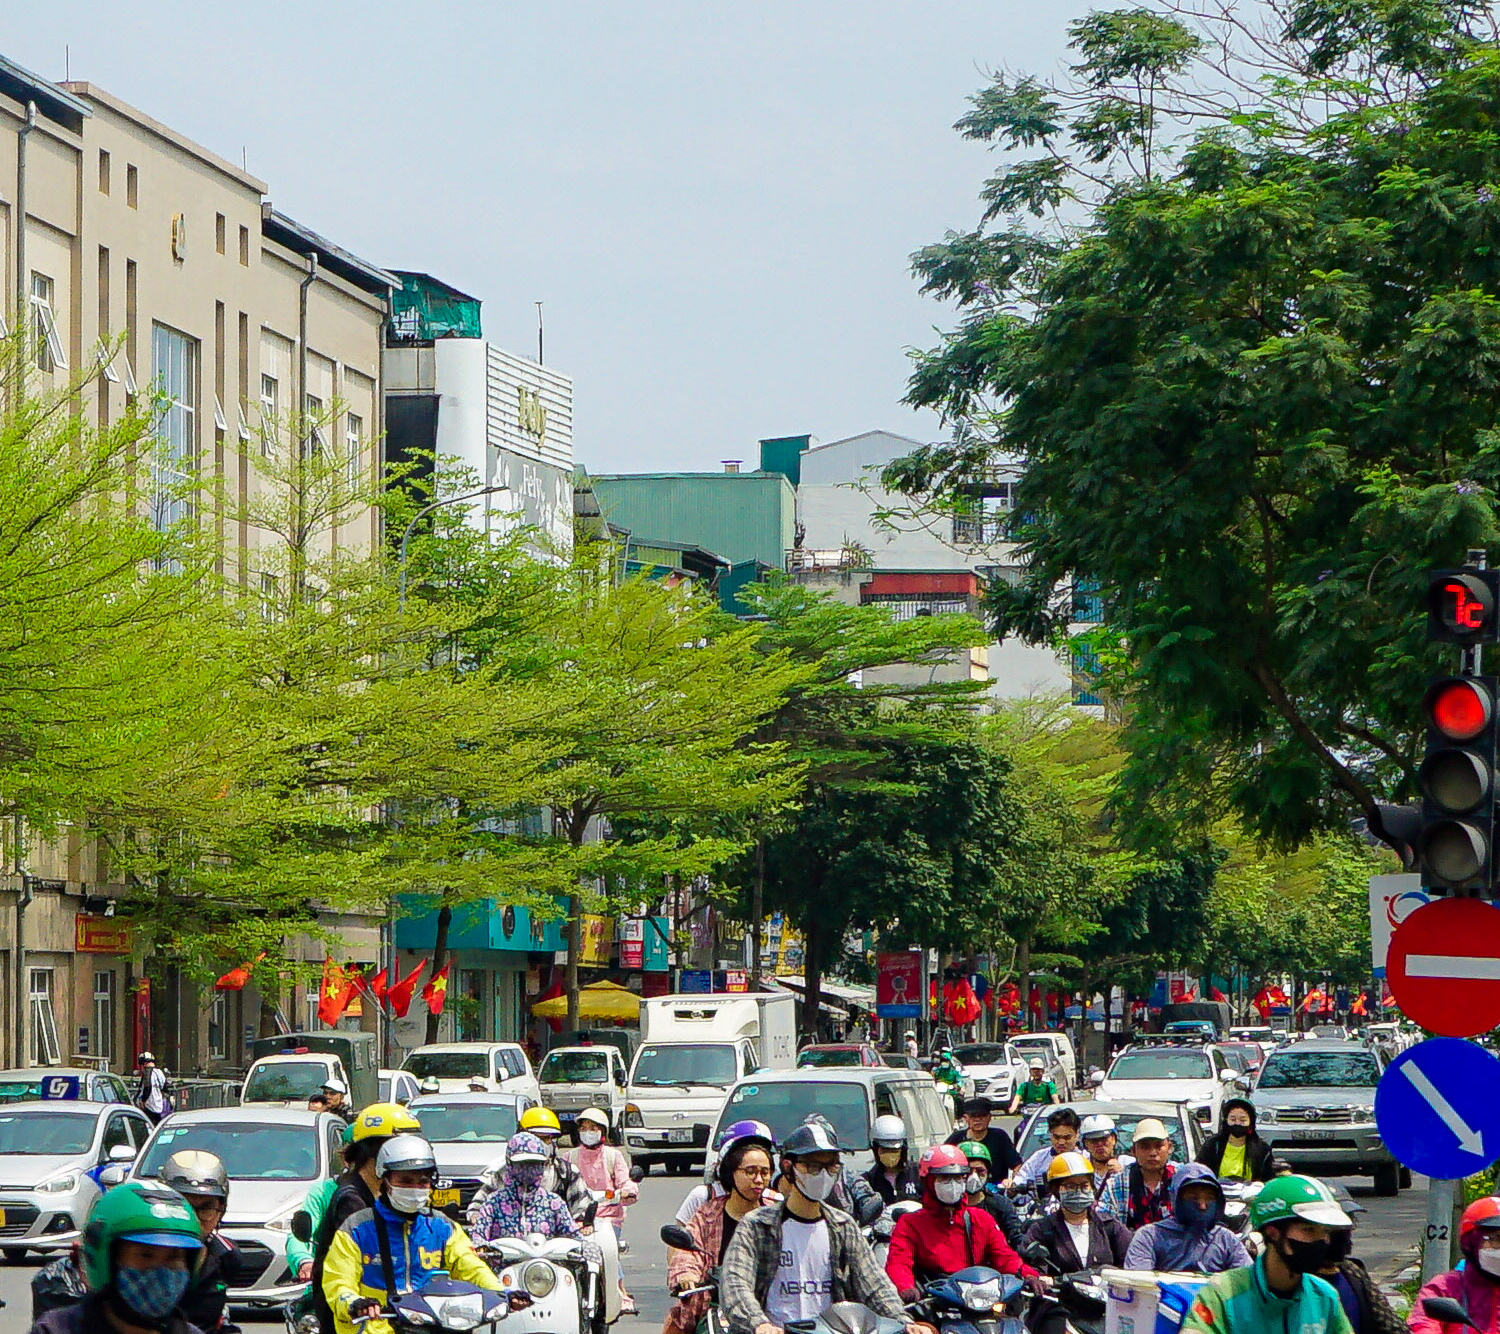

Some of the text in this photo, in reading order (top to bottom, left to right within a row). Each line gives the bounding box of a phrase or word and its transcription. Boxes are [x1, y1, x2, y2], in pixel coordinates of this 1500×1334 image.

[364, 1114, 383, 1127] be
[1427, 1225, 1448, 1240] C2
[418, 1246, 442, 1270] be
